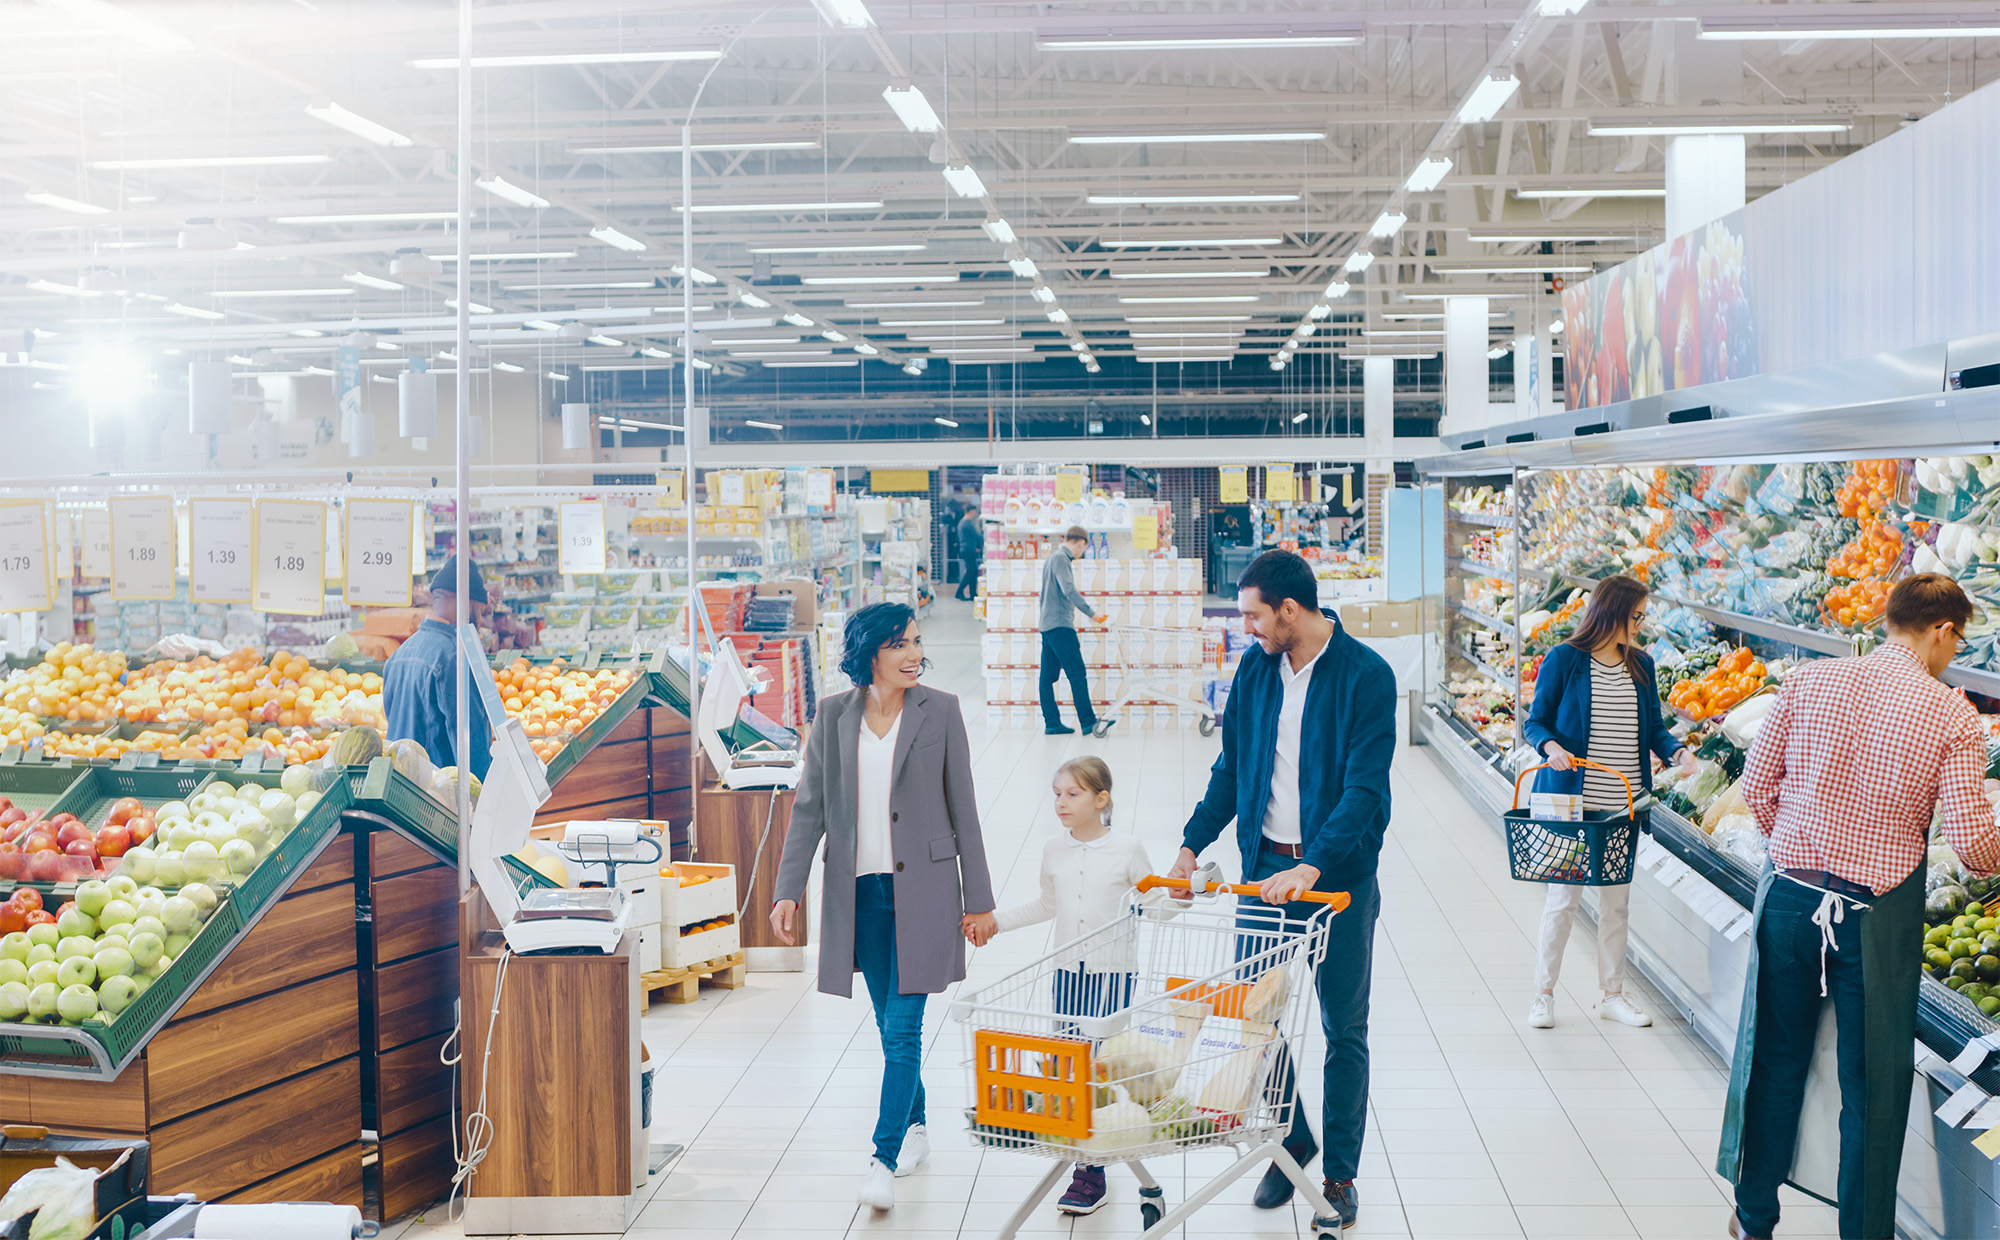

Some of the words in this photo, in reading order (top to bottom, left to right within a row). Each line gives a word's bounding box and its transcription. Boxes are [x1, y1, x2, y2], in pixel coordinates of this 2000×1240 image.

[571, 536, 593, 547] 1.39
[128, 547, 156, 561] 1.89
[207, 550, 236, 564] 1.39
[362, 551, 393, 566] 2.99
[2, 555, 31, 571] 1.79
[273, 555, 305, 571] 1.89
